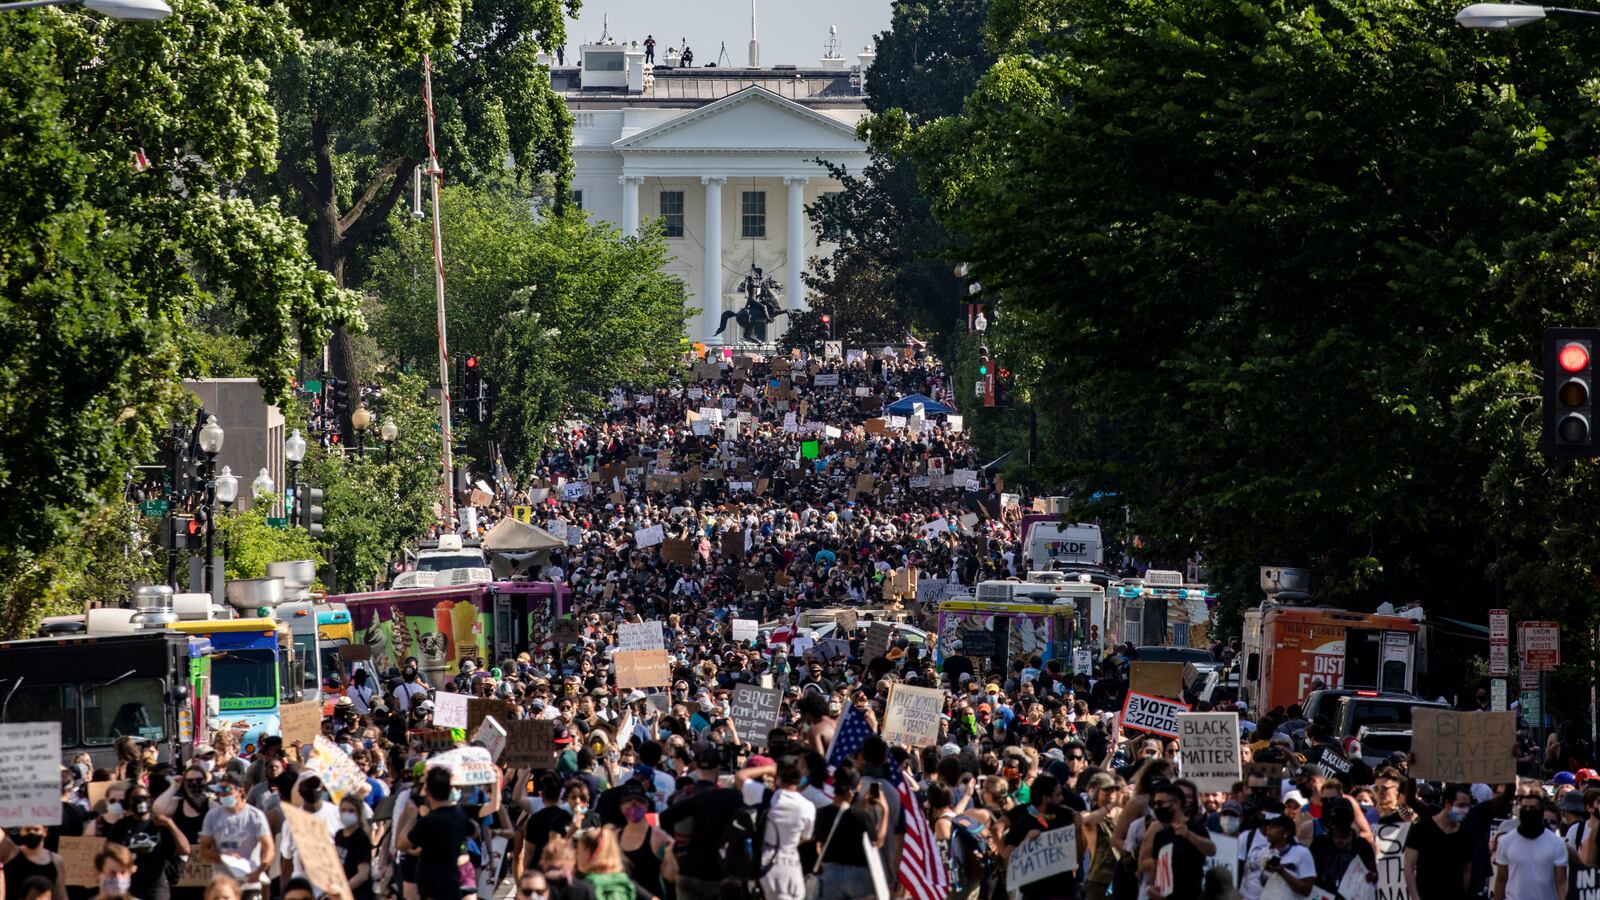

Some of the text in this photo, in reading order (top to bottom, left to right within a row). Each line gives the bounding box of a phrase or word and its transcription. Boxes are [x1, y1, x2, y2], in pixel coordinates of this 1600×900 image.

[1139, 698, 1178, 719] VOTE
[1133, 712, 1173, 732] 2020
[1184, 721, 1230, 735] BLACK
[1436, 713, 1514, 737] BLACK
[1183, 737, 1233, 749] LIVES
[1437, 741, 1512, 758] LIVES
[1182, 750, 1236, 765] MATTER
[1321, 749, 1338, 765] BLACK
[1437, 758, 1514, 780] MATTER
[1047, 828, 1075, 847] LIVES
[1012, 846, 1067, 881] MATTER
[1576, 868, 1596, 889] IN
